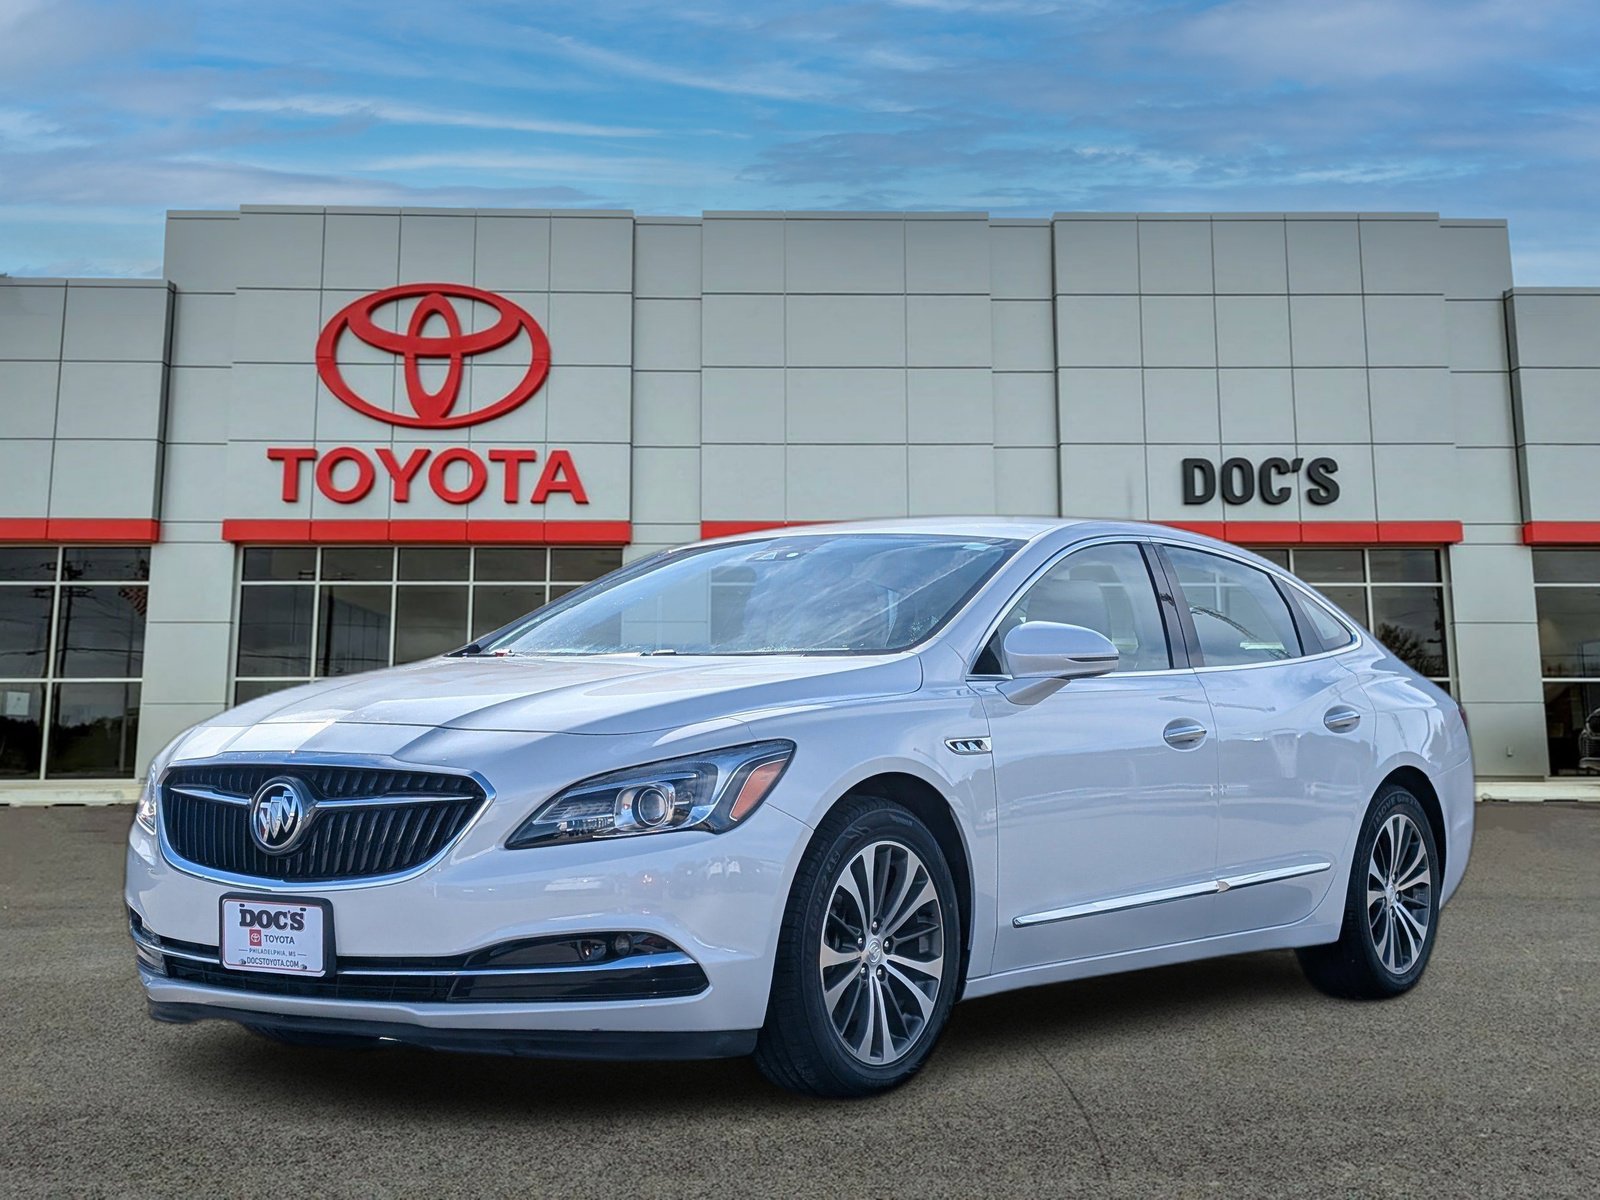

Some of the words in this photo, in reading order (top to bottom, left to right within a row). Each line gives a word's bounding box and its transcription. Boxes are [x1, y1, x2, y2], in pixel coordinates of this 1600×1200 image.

[267, 447, 589, 504] TOYOTA
[1182, 457, 1340, 506] DOC'S
[239, 908, 304, 931] DOC'S
[264, 934, 295, 945] TOYOTA
[249, 948, 287, 956] PHILADELPHIA,
[247, 957, 300, 968] DOCSTOYOTA.COM
